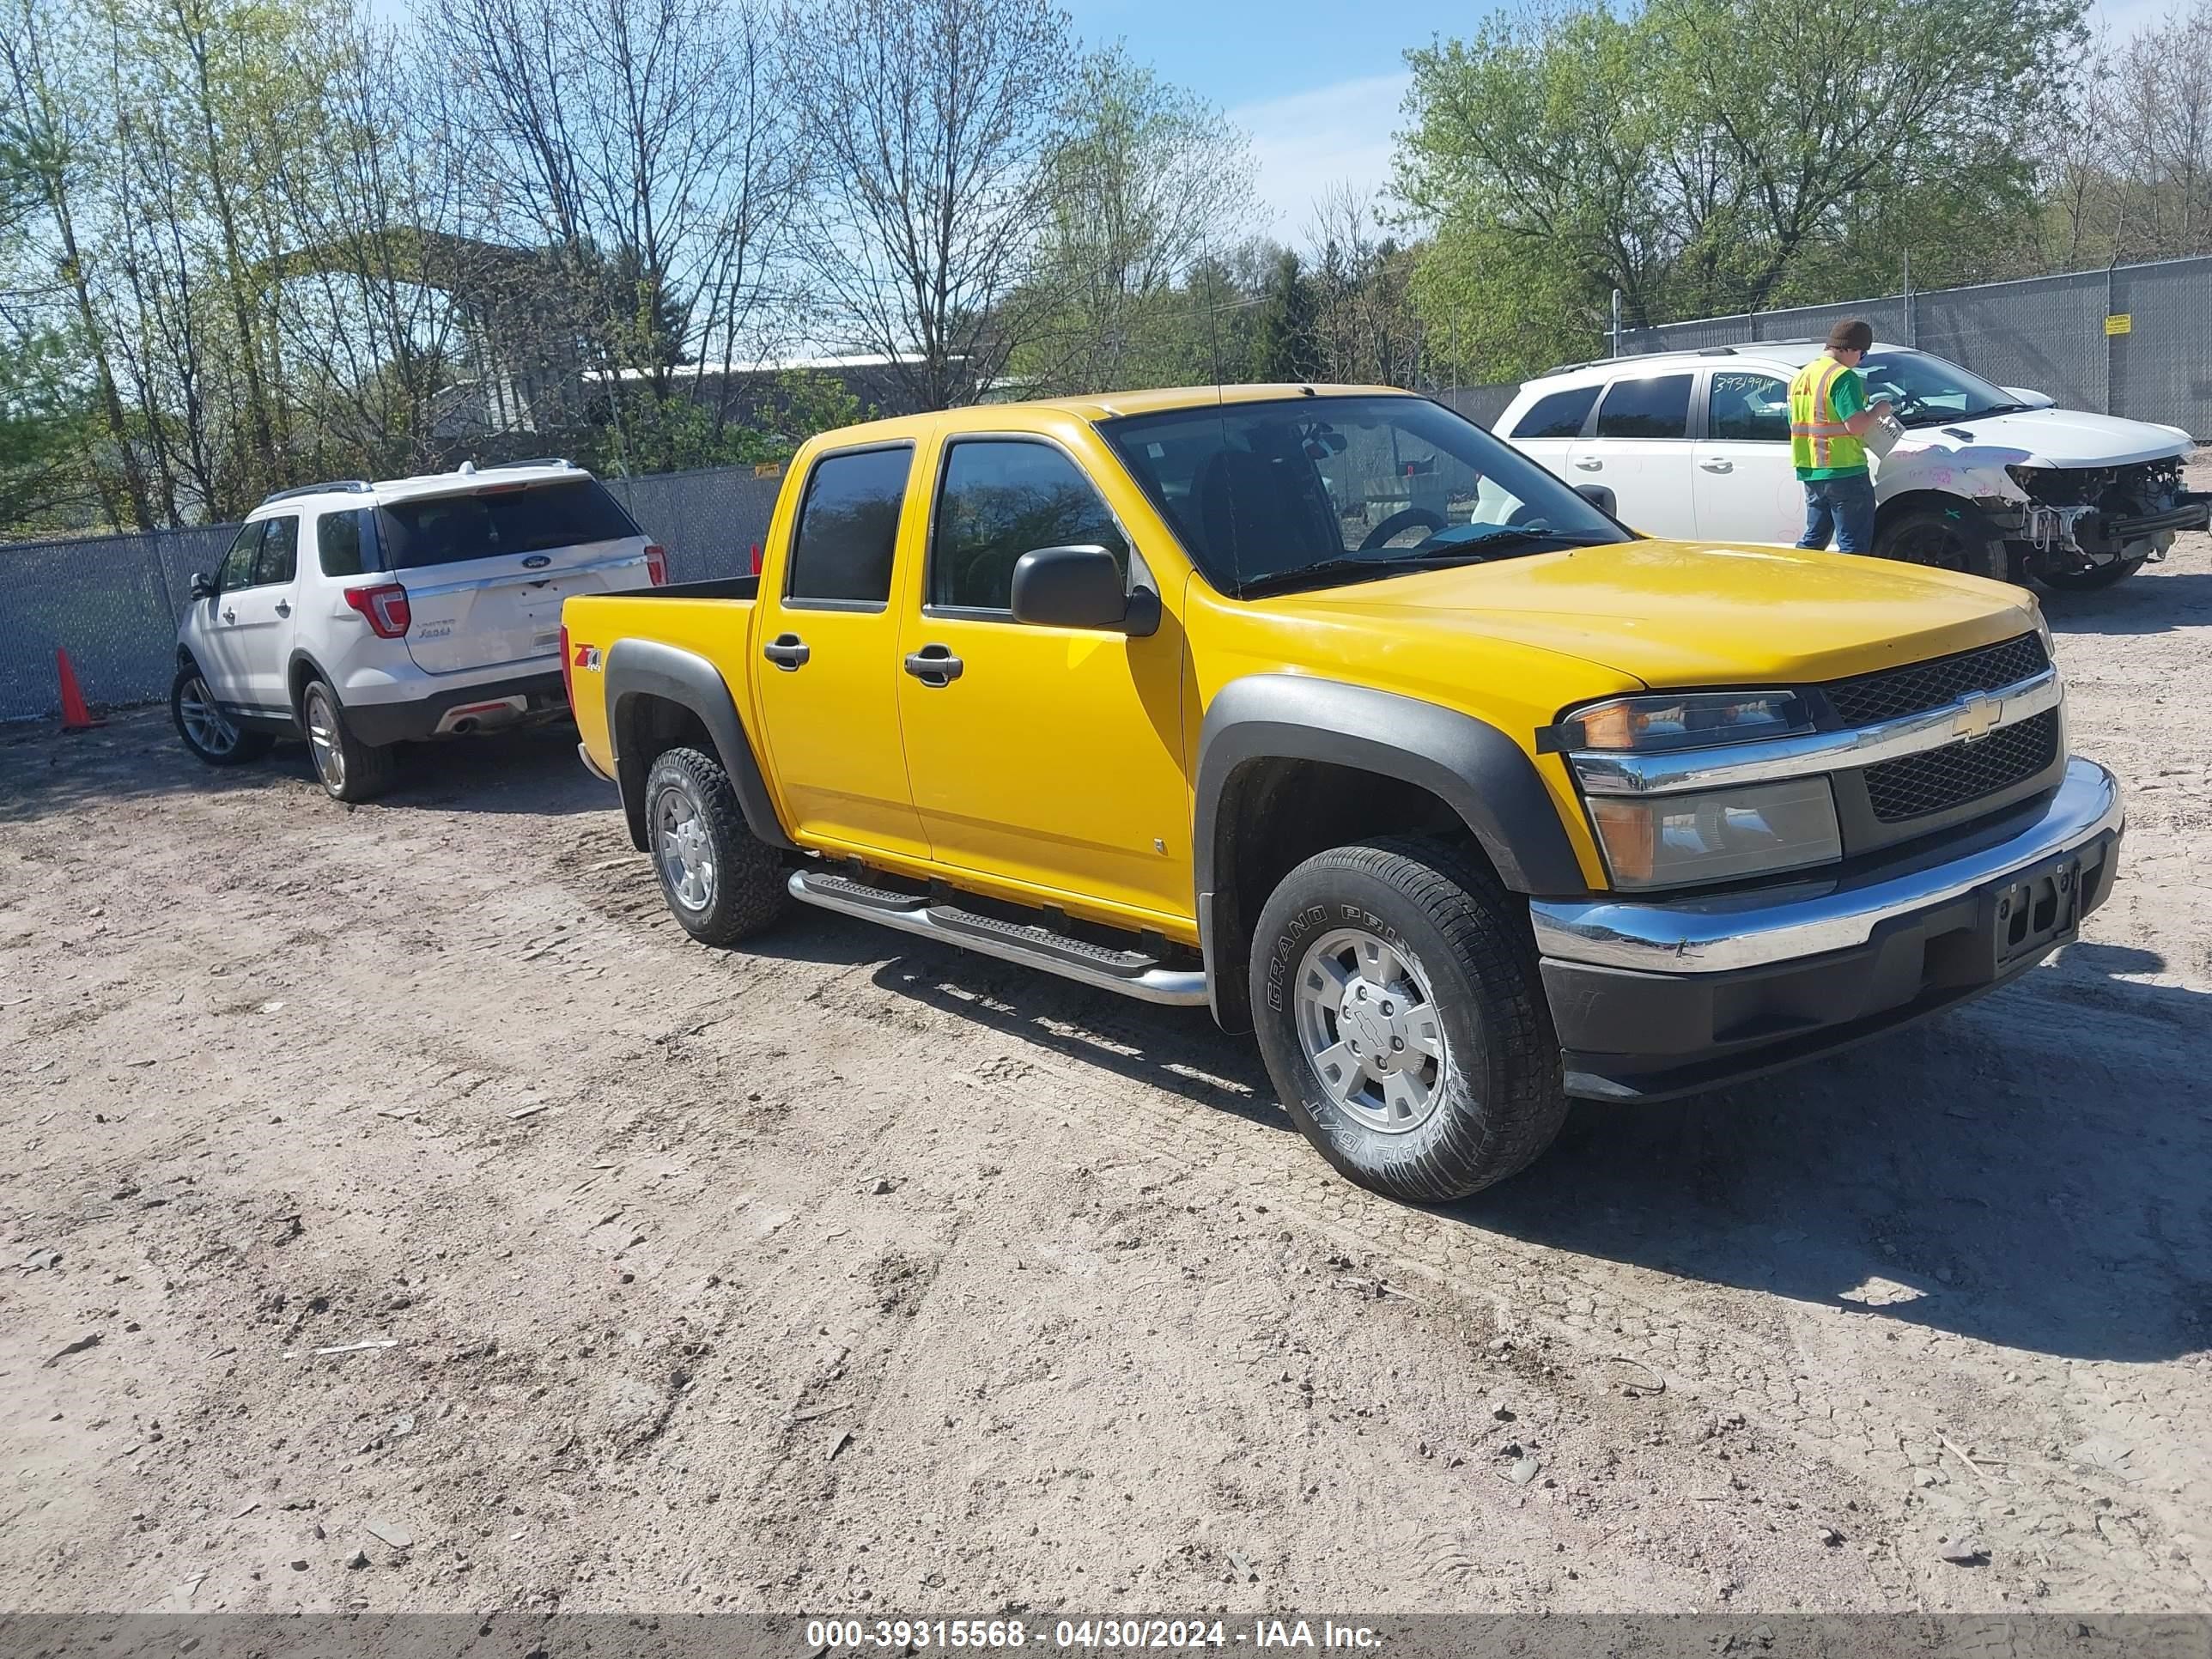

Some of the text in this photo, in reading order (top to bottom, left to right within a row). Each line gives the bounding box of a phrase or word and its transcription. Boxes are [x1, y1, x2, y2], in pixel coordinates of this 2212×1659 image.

[1714, 374, 1777, 394] 39319914
[1267, 904, 1421, 1013] GRAND PRIX
